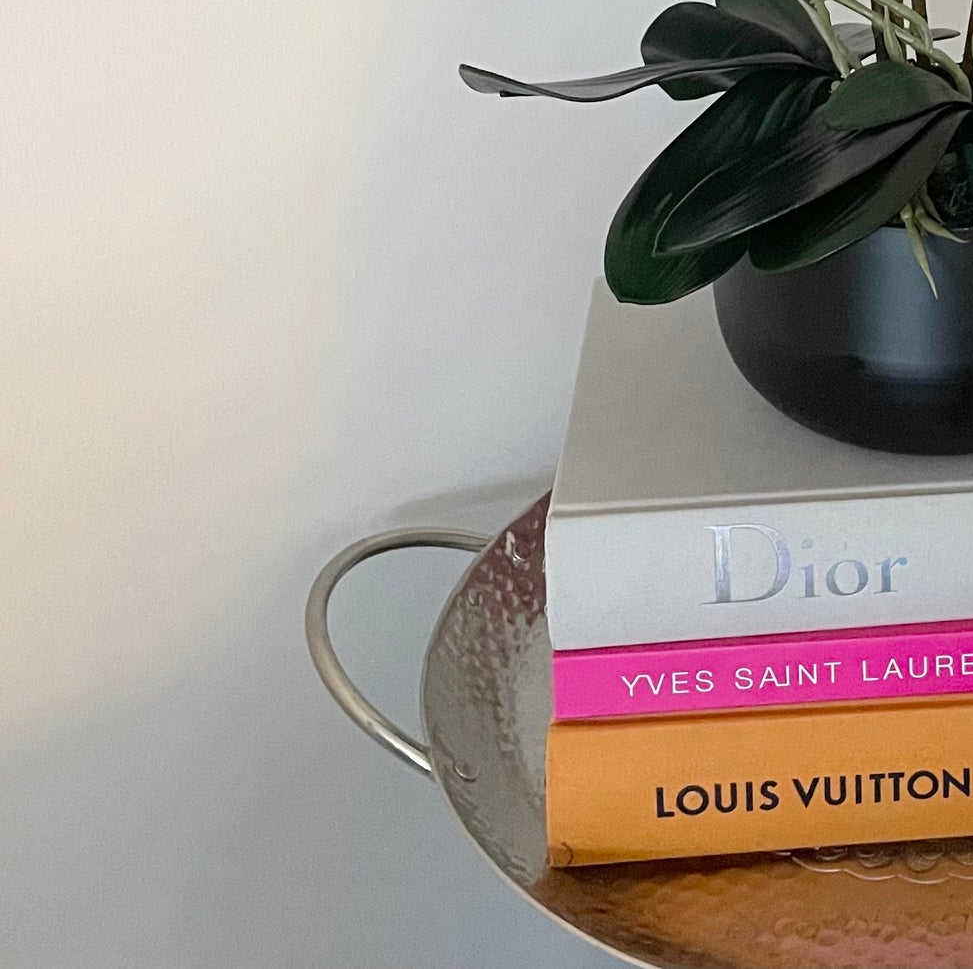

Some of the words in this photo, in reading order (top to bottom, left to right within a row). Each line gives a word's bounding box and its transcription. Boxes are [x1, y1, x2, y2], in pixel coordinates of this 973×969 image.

[701, 523, 908, 605] Dior
[620, 670, 715, 698] YVES
[734, 661, 843, 691] SAINT
[656, 780, 780, 819] LOUIS
[792, 768, 971, 809] VUITTON
